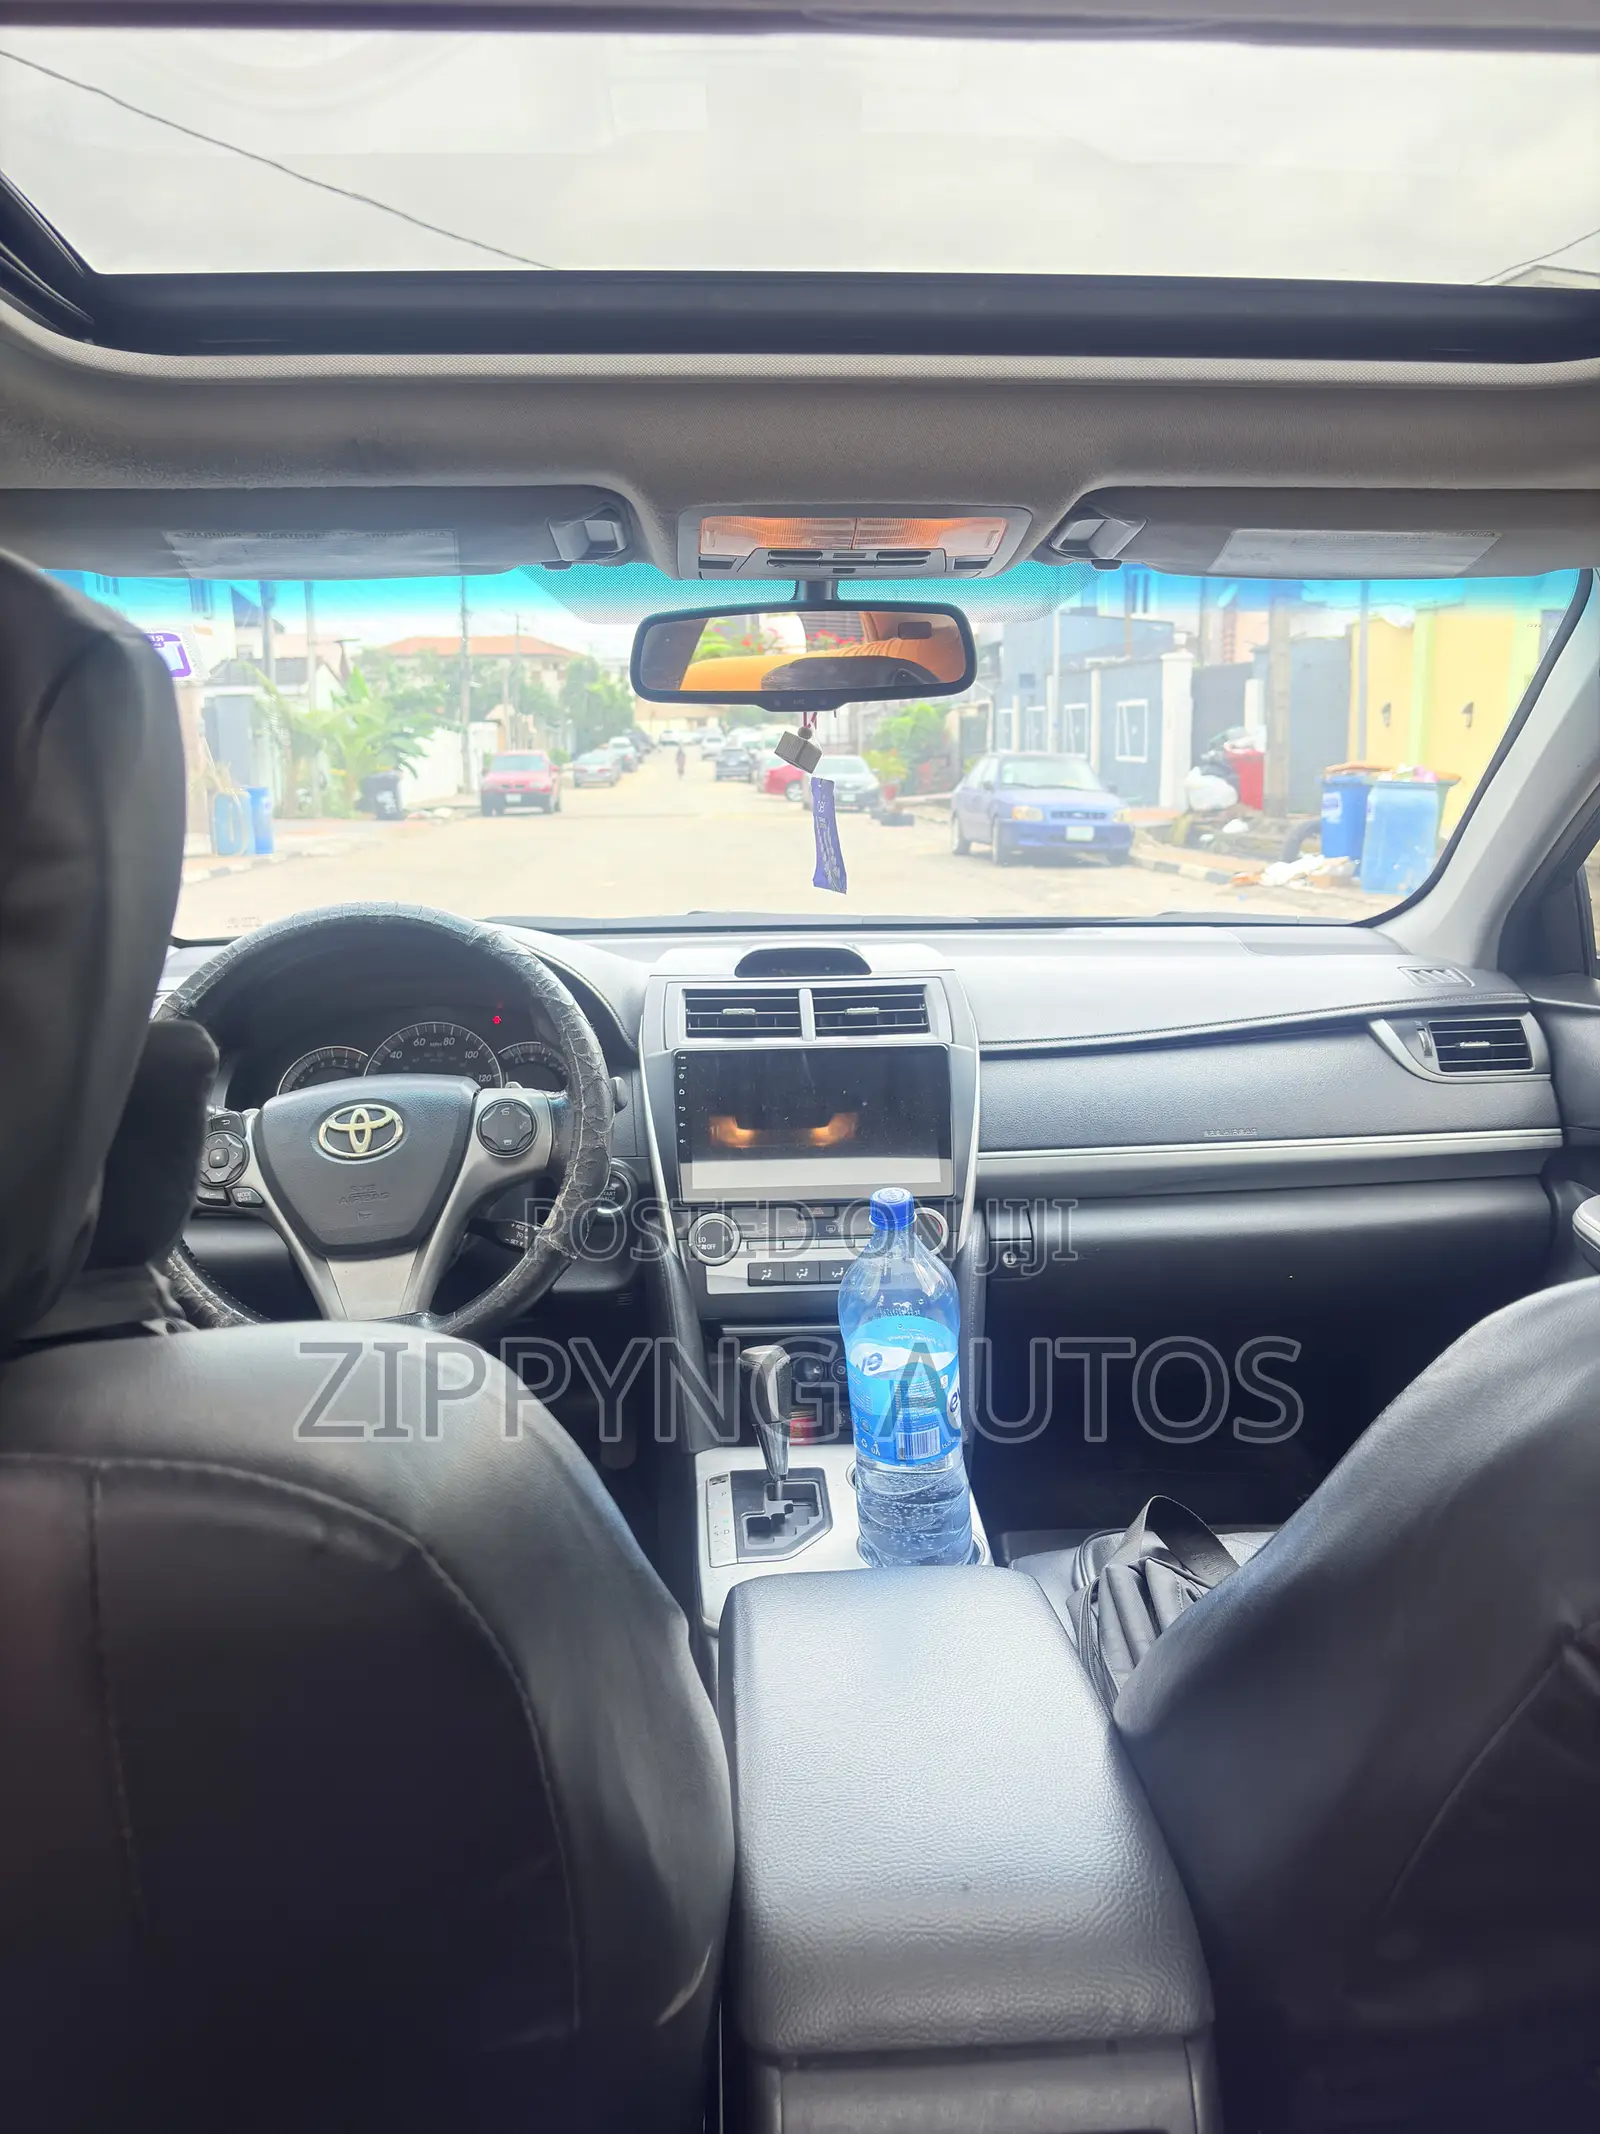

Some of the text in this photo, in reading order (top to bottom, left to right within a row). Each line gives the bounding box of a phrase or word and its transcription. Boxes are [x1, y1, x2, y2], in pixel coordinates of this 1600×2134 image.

[413, 1037, 426, 1047] 60
[443, 1037, 455, 1047] 80
[390, 1050, 403, 1060] 40
[464, 1050, 479, 1060] 100
[478, 1073, 492, 1083] 120
